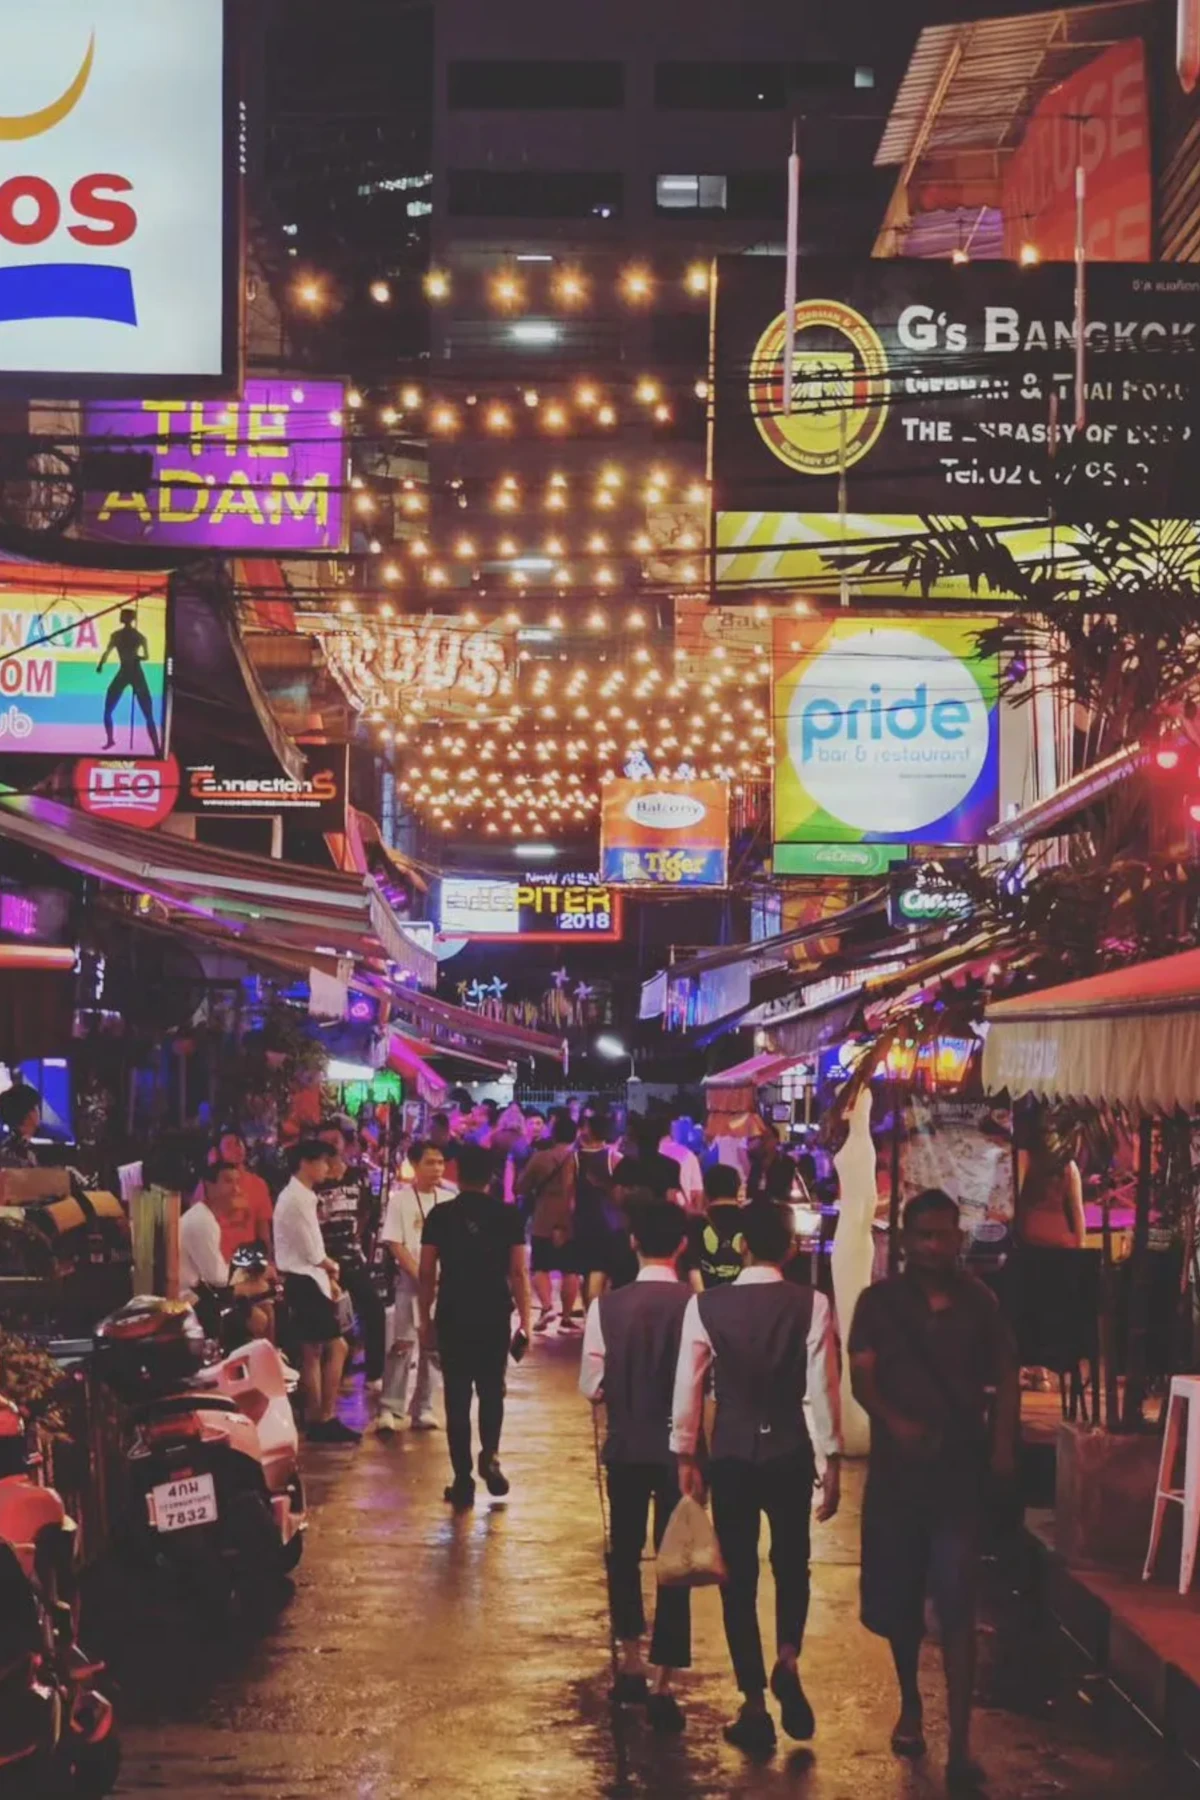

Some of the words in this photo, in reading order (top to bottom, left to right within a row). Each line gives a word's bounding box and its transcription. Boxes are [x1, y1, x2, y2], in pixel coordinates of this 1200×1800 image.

[1020, 373, 1042, 400] &
[141, 399, 290, 458] THE
[901, 417, 953, 442] THE
[961, 421, 1077, 444] BASSY
[1086, 424, 1117, 444] OF
[98, 469, 329, 526] ADAM
[801, 682, 972, 764] pride
[818, 746, 848, 762] bar
[874, 746, 971, 762] restaurant
[94, 772, 157, 798] LEO
[645, 850, 707, 882] Tiger
[560, 913, 610, 929] 2018
[165, 1506, 207, 1527] 7832
